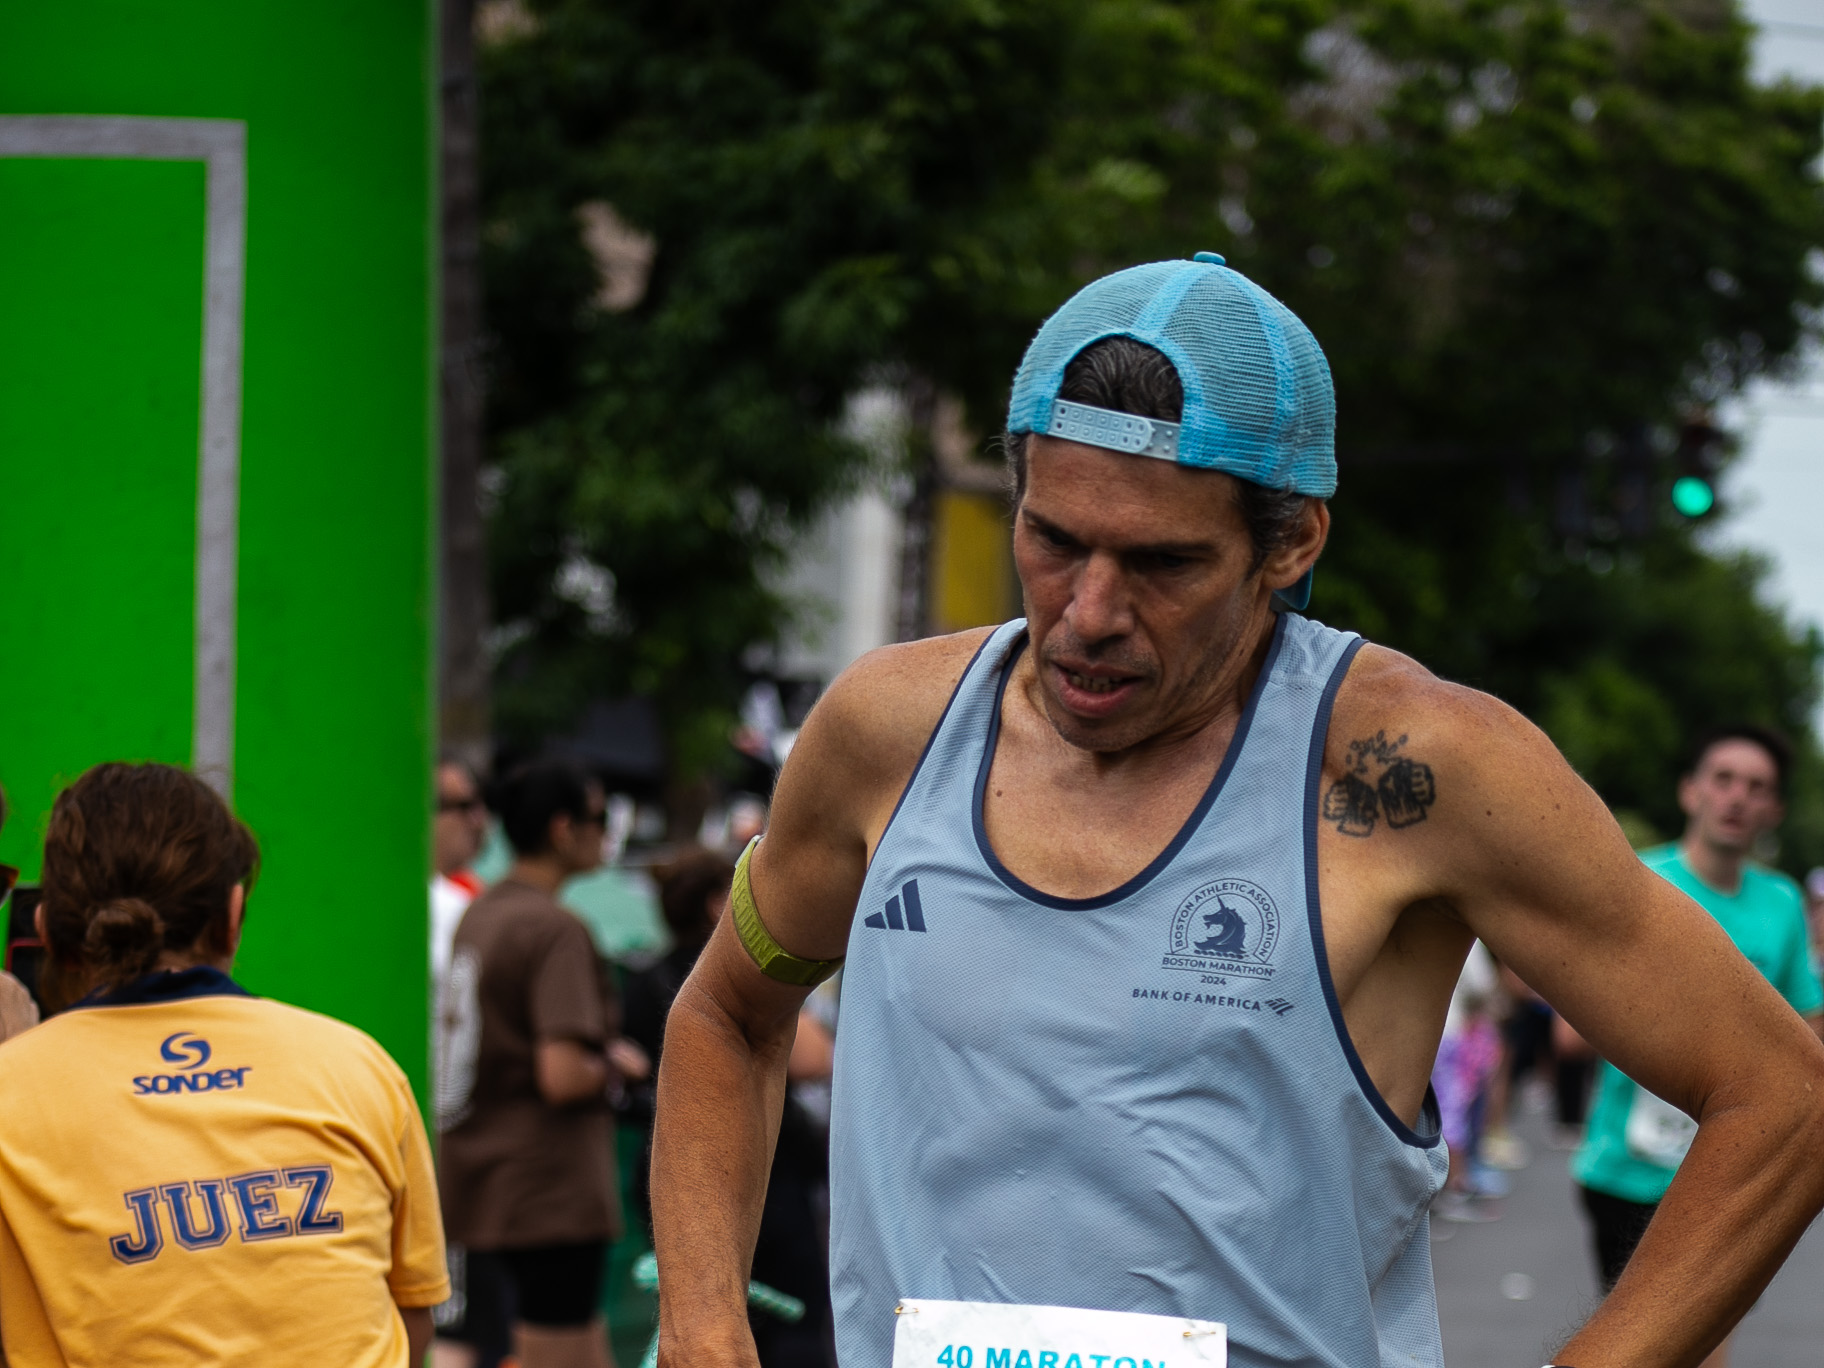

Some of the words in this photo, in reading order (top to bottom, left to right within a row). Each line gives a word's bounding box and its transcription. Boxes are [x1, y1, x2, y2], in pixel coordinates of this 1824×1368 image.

[1174, 901, 1194, 948] BOSTON
[1195, 882, 1246, 903] ATHLETIC
[1247, 888, 1276, 958] ASSOCIATION
[1162, 957, 1206, 969] BOSTON
[1201, 975, 1227, 986] 2024
[1132, 989, 1168, 1001] BANK
[1172, 992, 1191, 1002] OF
[1193, 994, 1261, 1012] AMERICA
[109, 1164, 344, 1265] JUEZ
